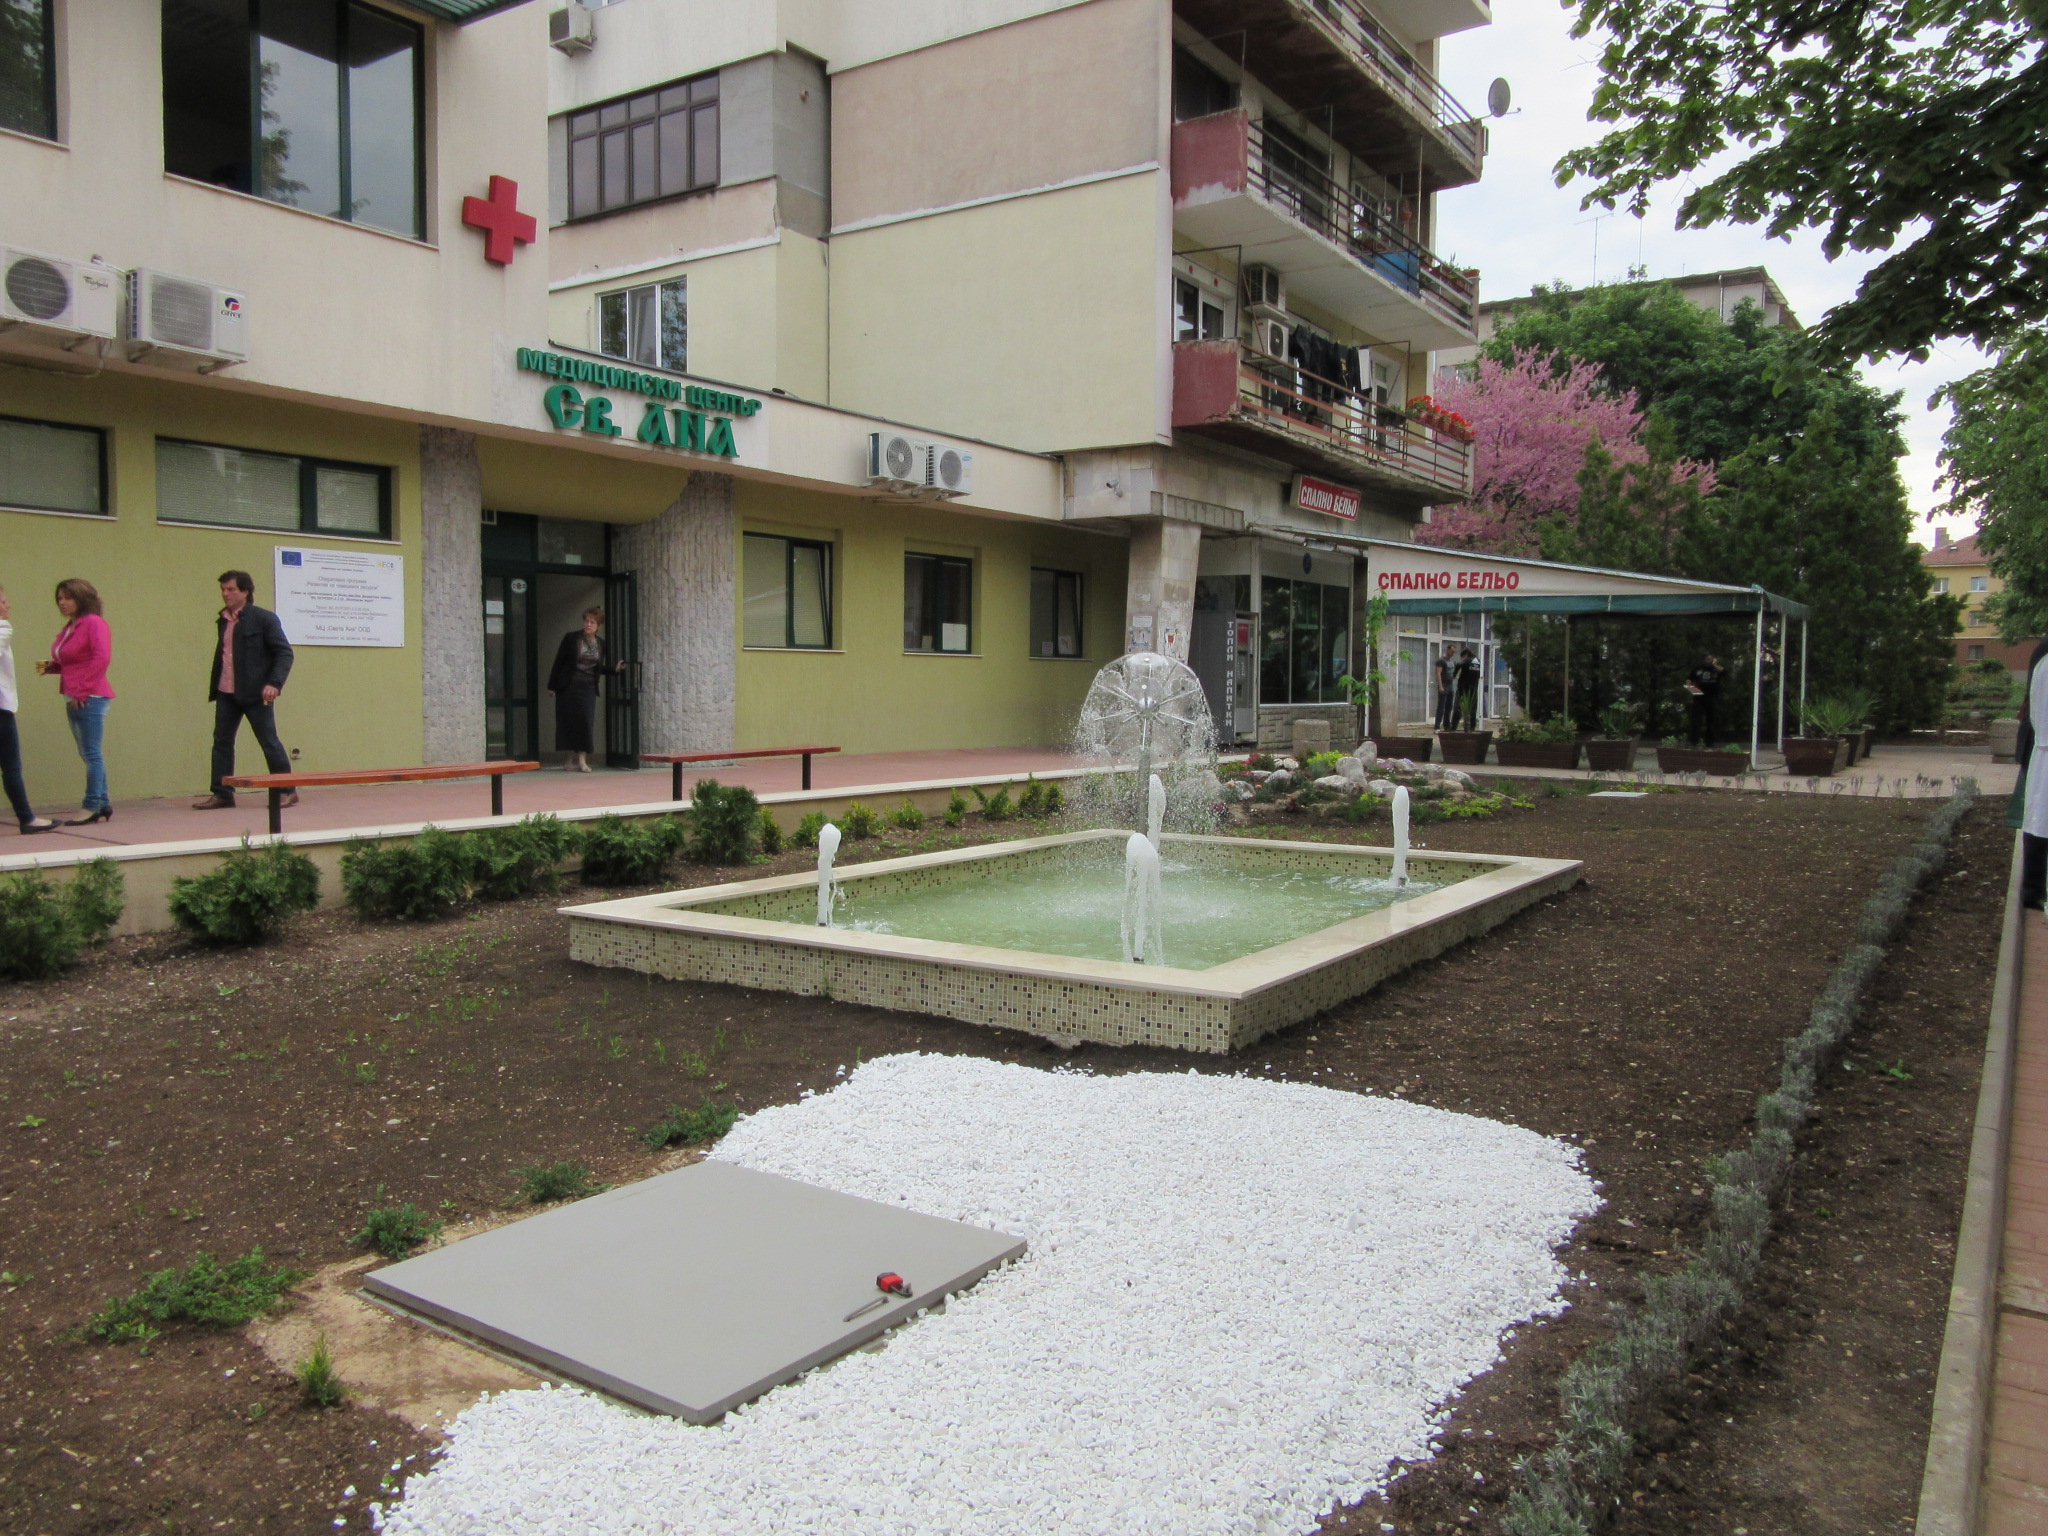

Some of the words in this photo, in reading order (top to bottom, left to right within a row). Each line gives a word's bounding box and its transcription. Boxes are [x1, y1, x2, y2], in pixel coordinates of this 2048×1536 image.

[221, 309, 242, 319] GREE
[517, 347, 682, 401] МЕДИЦИНСКИ
[685, 385, 762, 418] ЦЕНТЪР
[1300, 485, 1333, 511] СПАЛНО
[1333, 494, 1358, 517] БЕЛЬО
[1378, 571, 1451, 590] СПАЛНО
[1457, 571, 1520, 590] БЕЛЬО
[1226, 621, 1234, 661] ТОПЛИ
[1225, 670, 1233, 726] НАПИТКИ
